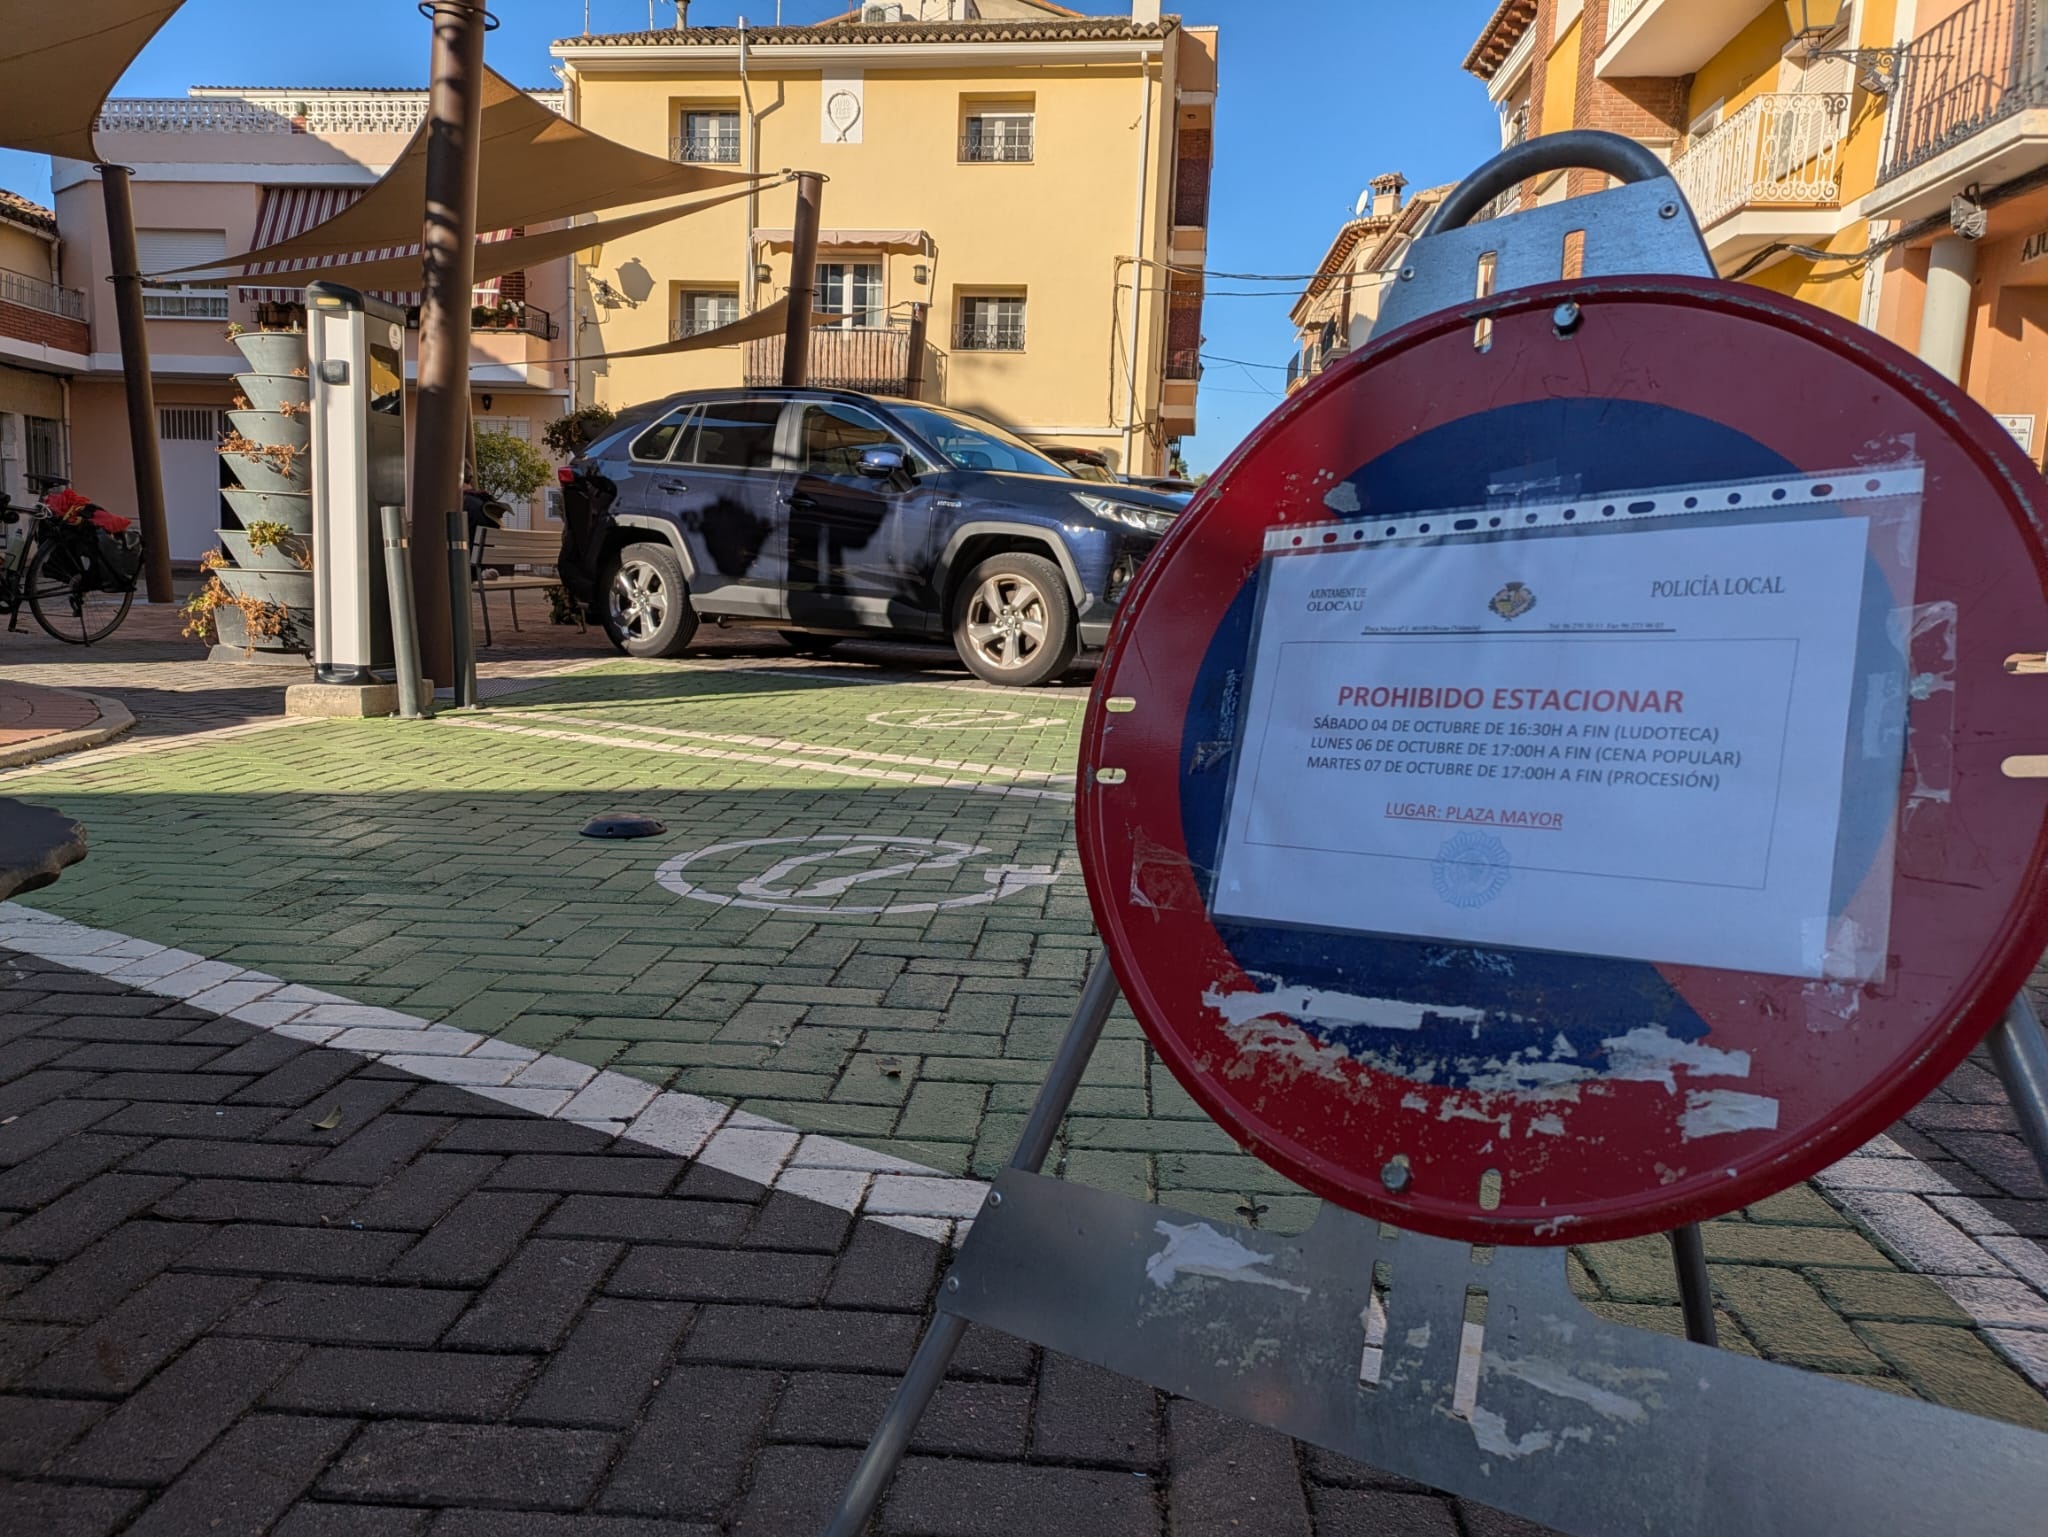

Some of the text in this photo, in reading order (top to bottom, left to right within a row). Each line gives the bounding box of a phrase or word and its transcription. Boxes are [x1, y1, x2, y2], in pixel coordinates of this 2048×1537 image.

[1651, 574, 1785, 598] POLICÍA LOCAL
[1306, 600, 1364, 612] OLOCAU
[1337, 686, 1684, 713] PROHIBIDO ESTACIONAR
[1313, 714, 1719, 744] SÁBADO 04 DE OCTUBRE DE 16:30H A FIN (LUDOTECA)
[1310, 737, 1741, 768] LUNES 06 DE OCTUBRE DE 17:00H A FIN (CENA POPULAR)
[1306, 756, 1720, 791] MARTES 07 DE OCTUBRE DE 17:00H A FIN (PROCESIÓN)
[1385, 801, 1564, 827] LUGAR: PLAZA MAYOR
